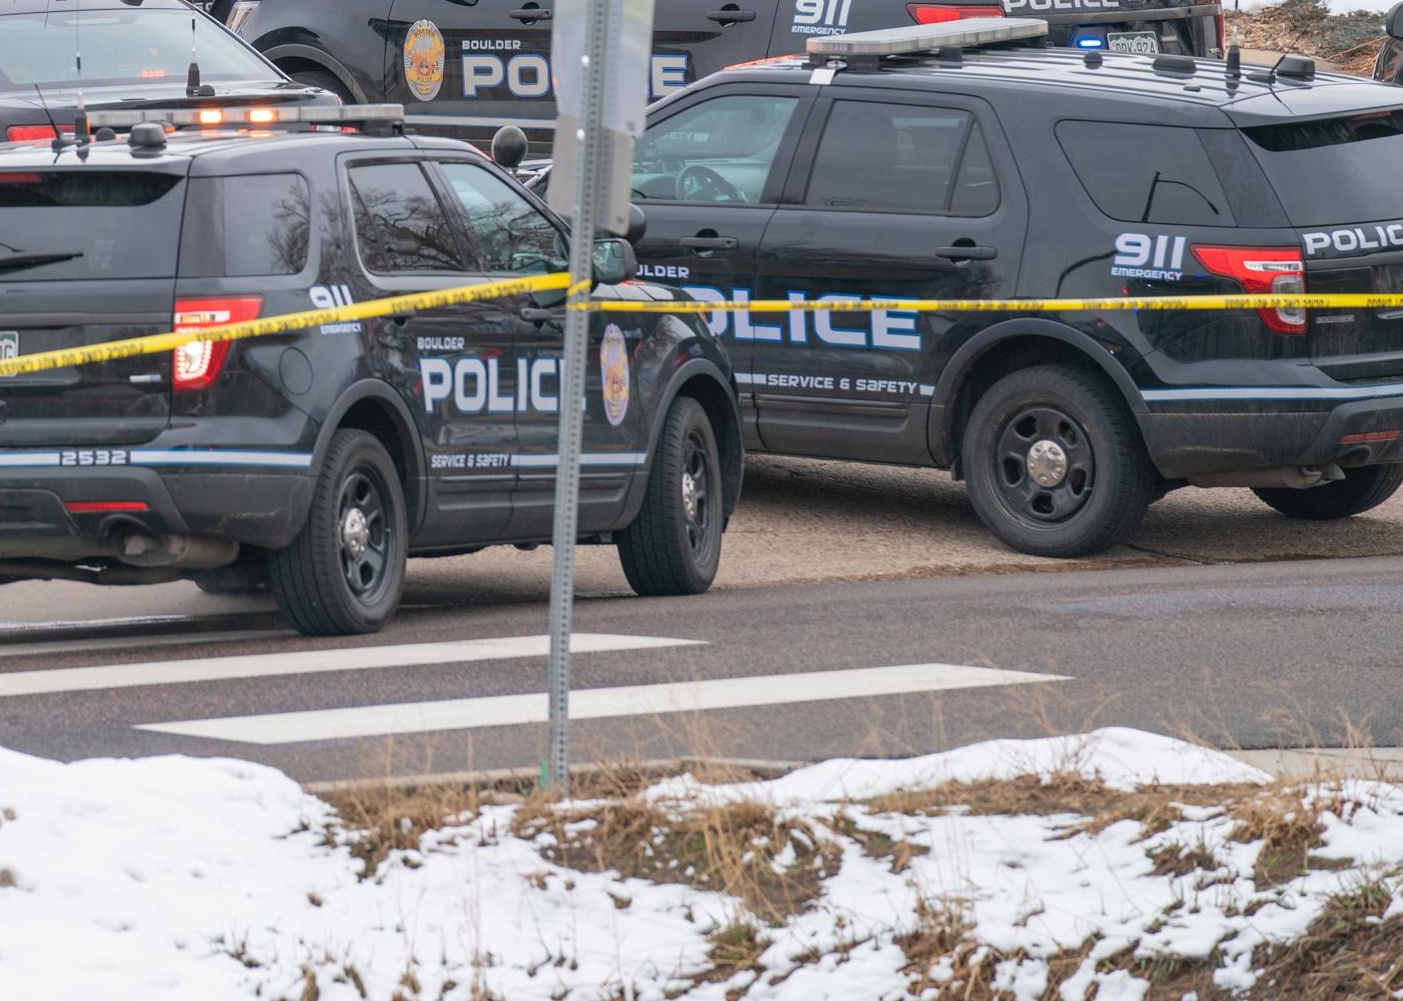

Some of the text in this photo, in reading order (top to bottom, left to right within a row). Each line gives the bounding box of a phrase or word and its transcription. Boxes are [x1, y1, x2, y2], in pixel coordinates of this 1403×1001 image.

[791, 25, 847, 35] EMERGENCY
[461, 39, 522, 50] BOULDER
[461, 53, 688, 99] POE
[1302, 225, 1403, 255] POLIC
[1113, 232, 1188, 270] 911
[635, 264, 690, 279] ULDER
[1110, 267, 1183, 281] EMERGENCY
[681, 285, 922, 351] OLICE
[417, 336, 465, 350] BOULDER
[419, 357, 587, 413] POLIC
[767, 373, 834, 390] SERVICE
[839, 377, 851, 390] &
[61, 450, 127, 466] 2532
[431, 454, 466, 469] SERVICE
